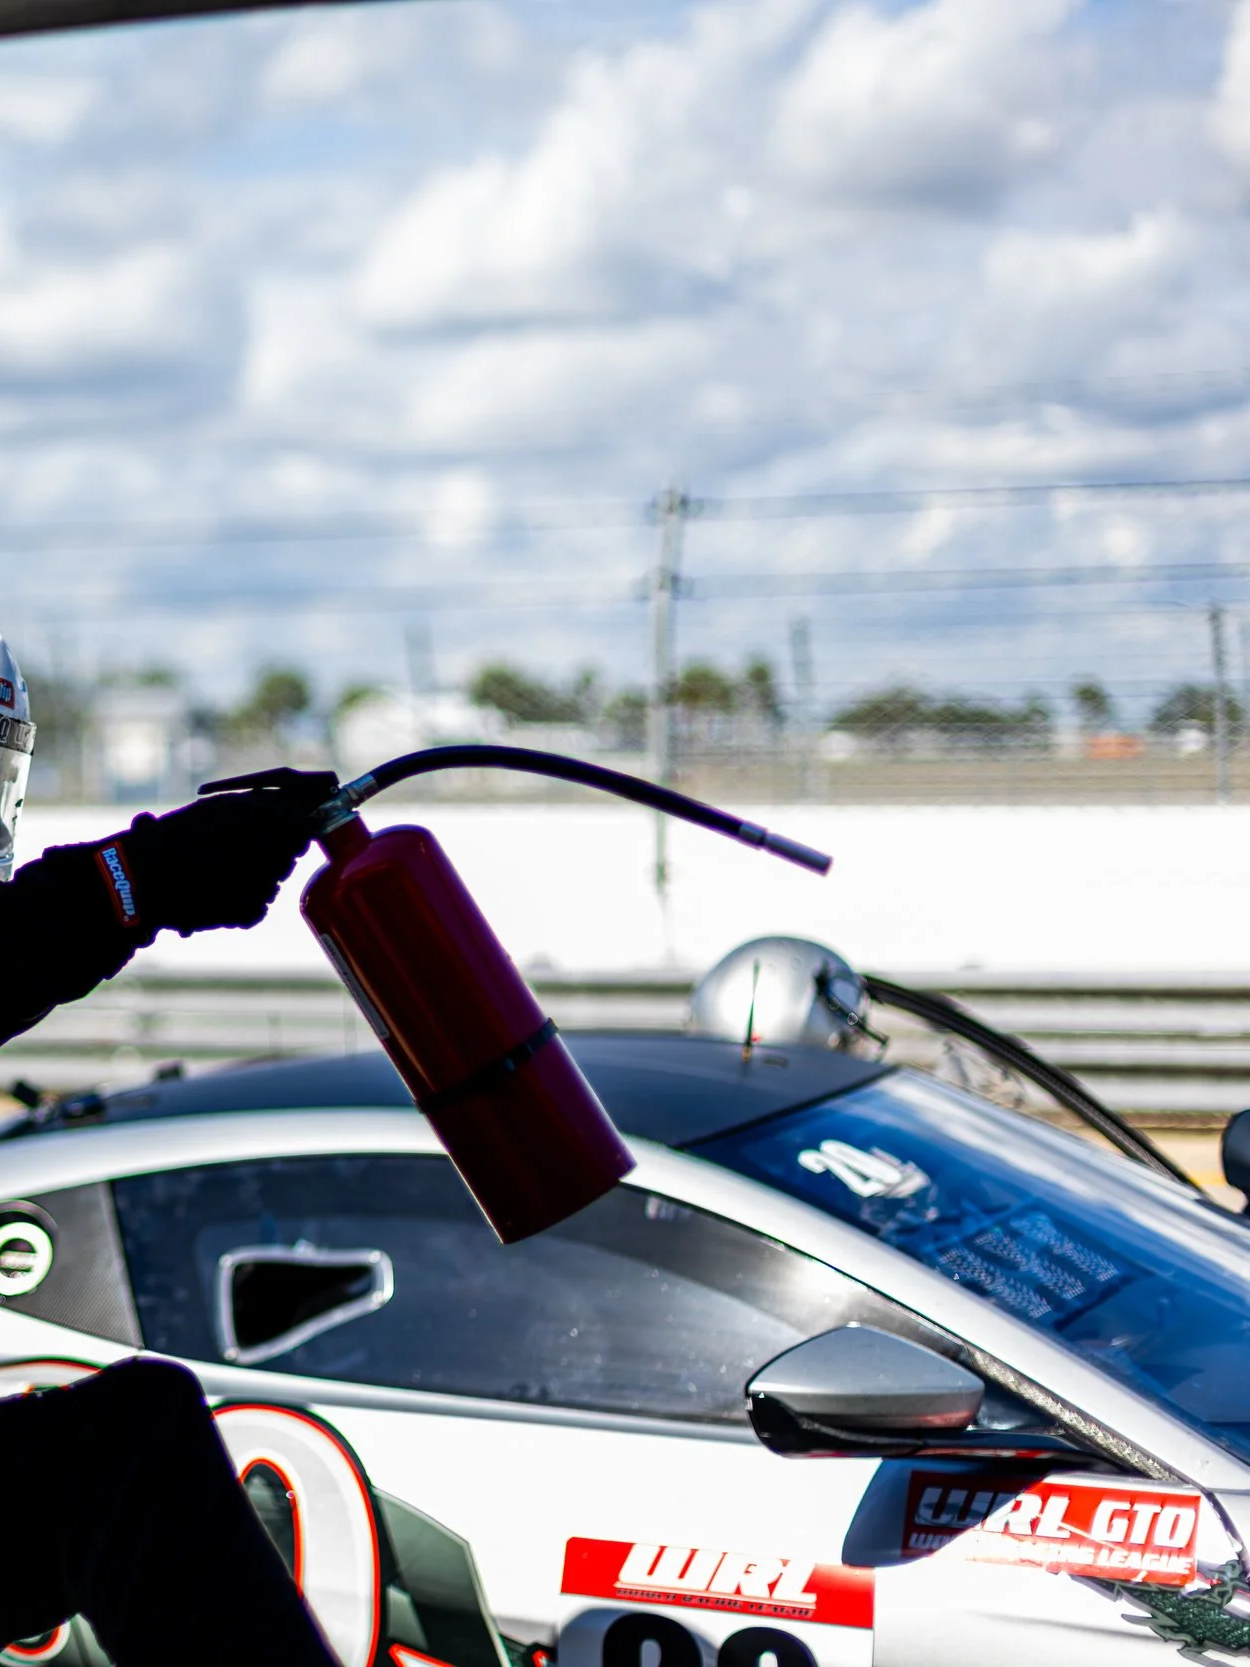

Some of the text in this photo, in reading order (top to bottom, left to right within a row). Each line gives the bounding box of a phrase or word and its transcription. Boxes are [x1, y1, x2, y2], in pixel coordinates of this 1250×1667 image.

[102, 847, 135, 916] RaceQuip
[913, 1487, 1197, 1549] WRL GTO
[617, 1543, 817, 1604] WRL
